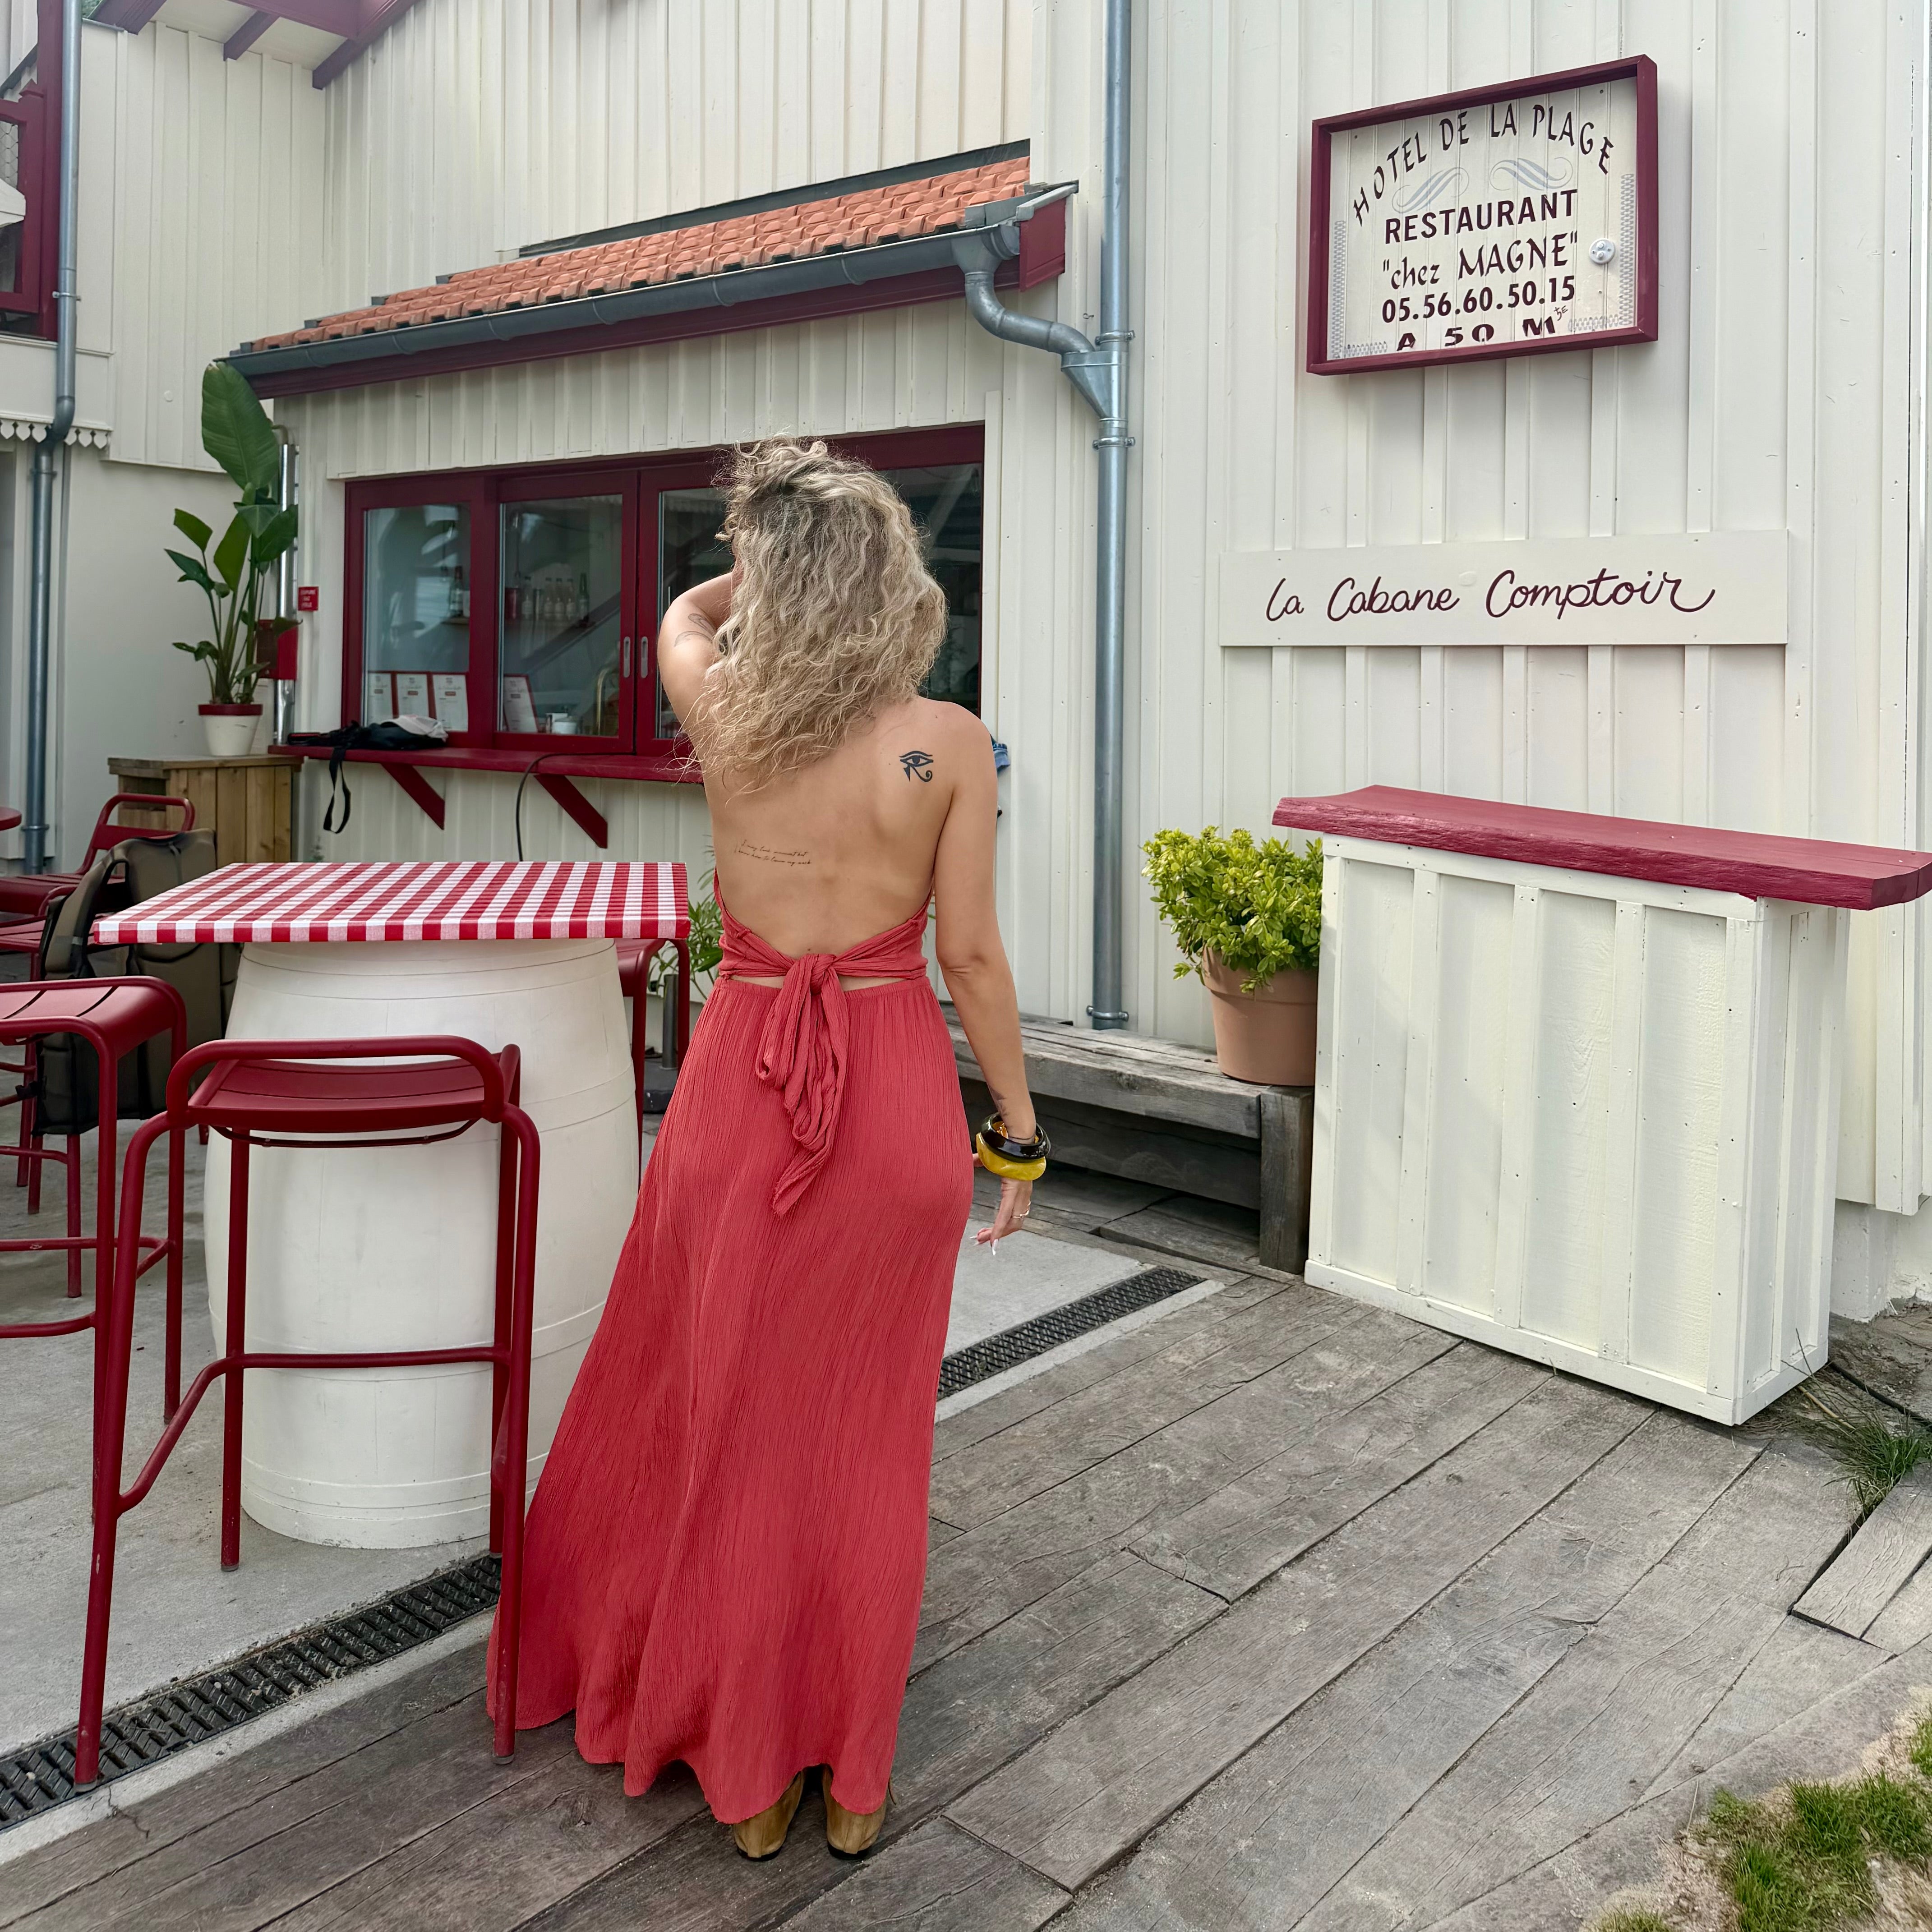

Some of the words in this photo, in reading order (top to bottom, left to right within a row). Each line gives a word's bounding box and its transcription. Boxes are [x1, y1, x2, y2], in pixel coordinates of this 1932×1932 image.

[1353, 132, 1427, 226] HOTEL
[1439, 111, 1470, 151] DE
[1489, 102, 1517, 137] LA
[1532, 104, 1614, 175] PLAGE
[1385, 189, 1577, 244] RESTAURANT
[1383, 256, 1440, 290] "chez
[1458, 231, 1577, 280] MAGNE"
[1382, 275, 1575, 323] 05.56.60.50.15
[1397, 332, 1416, 351] A
[1445, 323, 1494, 346] 50
[1522, 315, 1555, 337] M
[1266, 577, 1305, 622] La
[1327, 576, 1460, 622] Cabane
[1485, 567, 1716, 620] Comptoir
